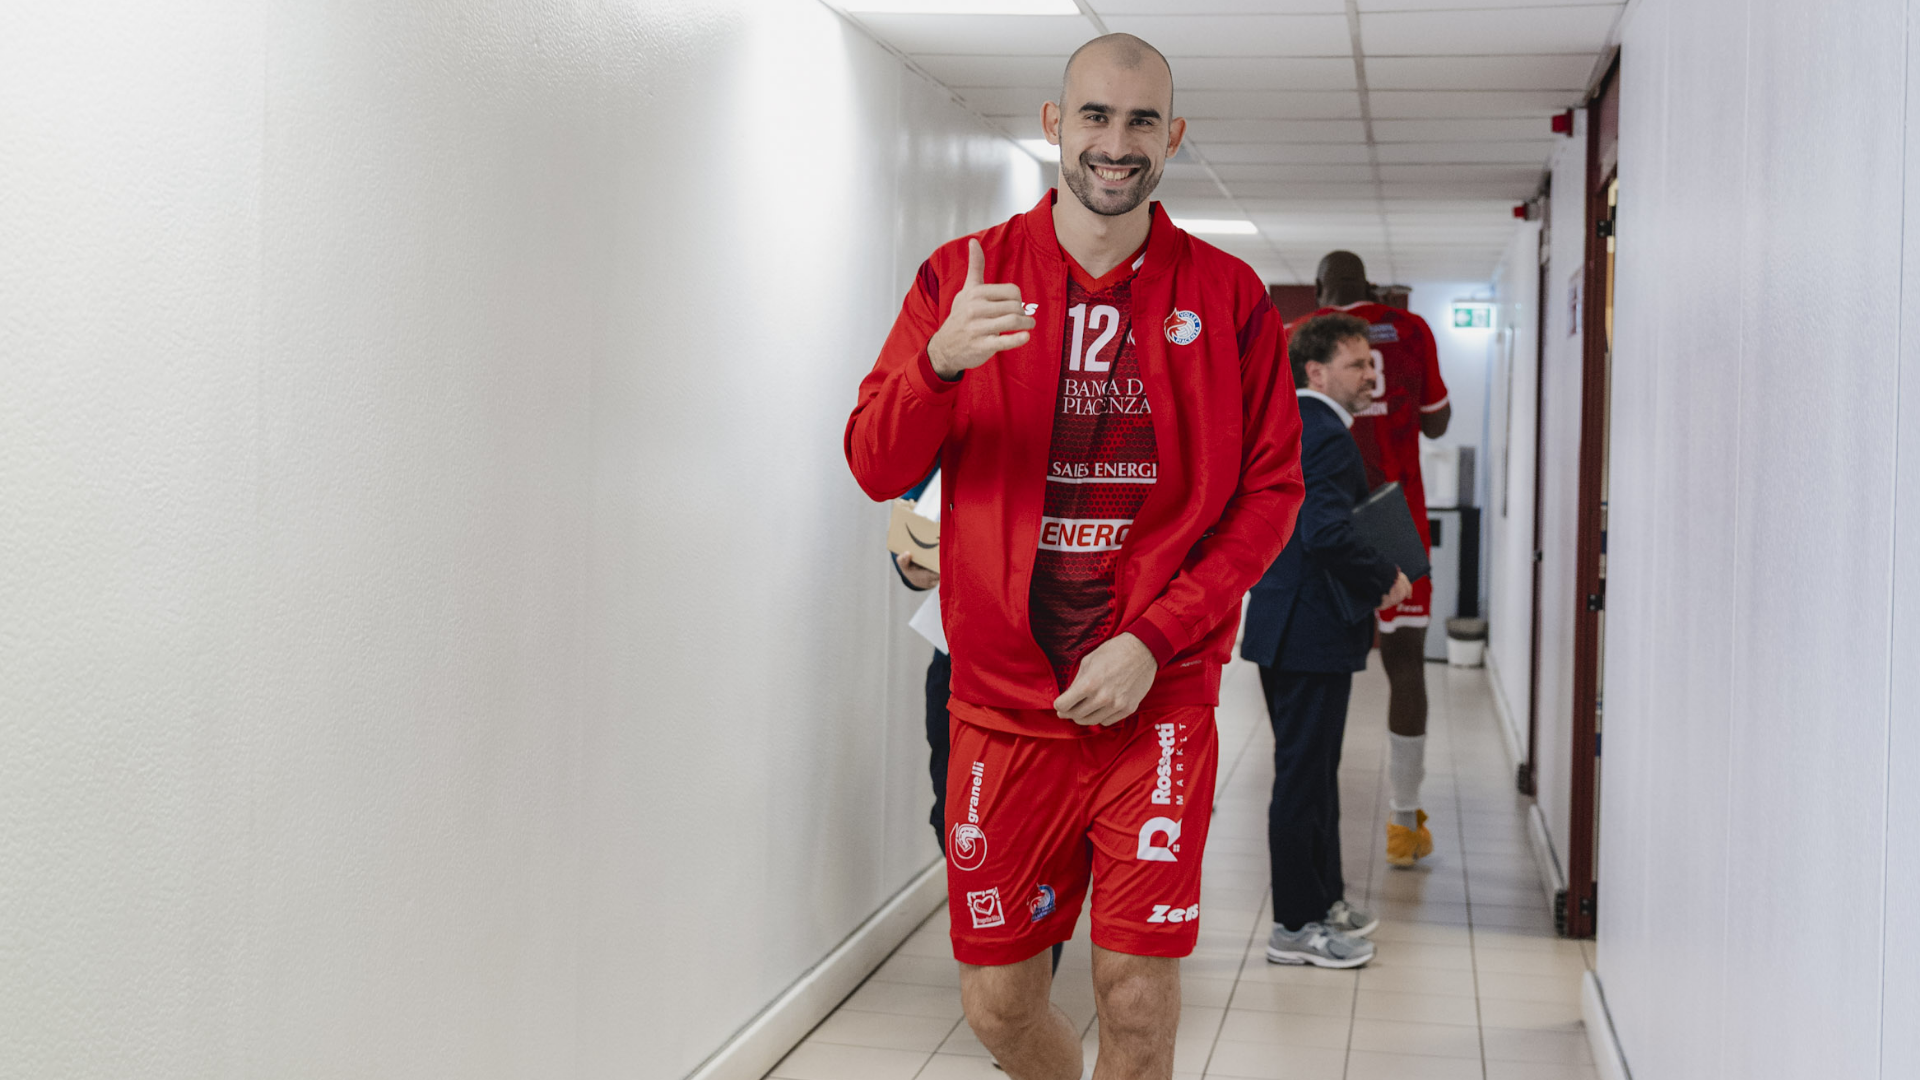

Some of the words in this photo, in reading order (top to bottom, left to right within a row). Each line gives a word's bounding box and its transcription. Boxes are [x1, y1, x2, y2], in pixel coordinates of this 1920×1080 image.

[1068, 303, 1120, 372] 12
[1126, 378, 1147, 397] D
[1094, 462, 1158, 478] ENERGI
[967, 760, 985, 824] granelli
[1151, 722, 1176, 805] Rossetti
